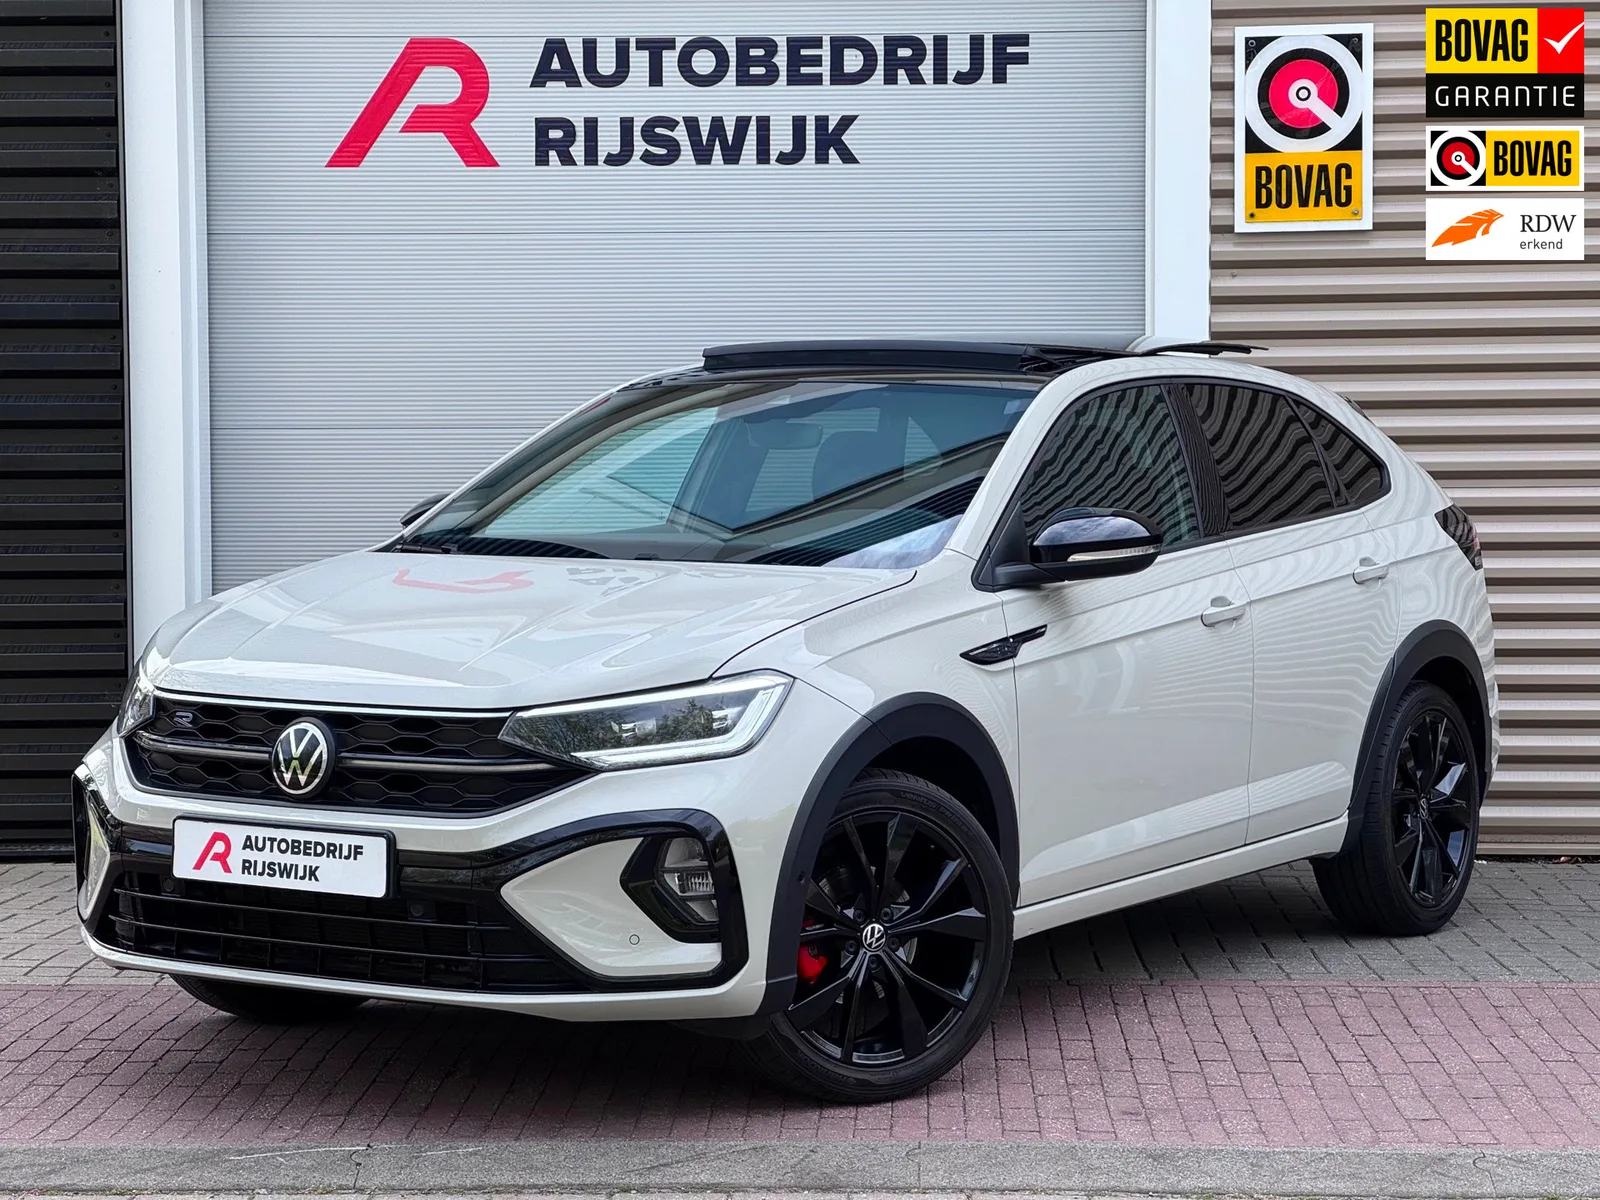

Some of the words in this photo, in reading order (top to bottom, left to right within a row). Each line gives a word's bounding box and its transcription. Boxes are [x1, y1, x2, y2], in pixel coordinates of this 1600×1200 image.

[529, 33, 1031, 88] AUTOBEDRIJF
[534, 114, 861, 167] RIJSWIJK
[1255, 162, 1353, 209] BOVAG
[241, 834, 364, 862] AUTOBEDRIJF
[241, 858, 320, 883] RIJSWIJK
